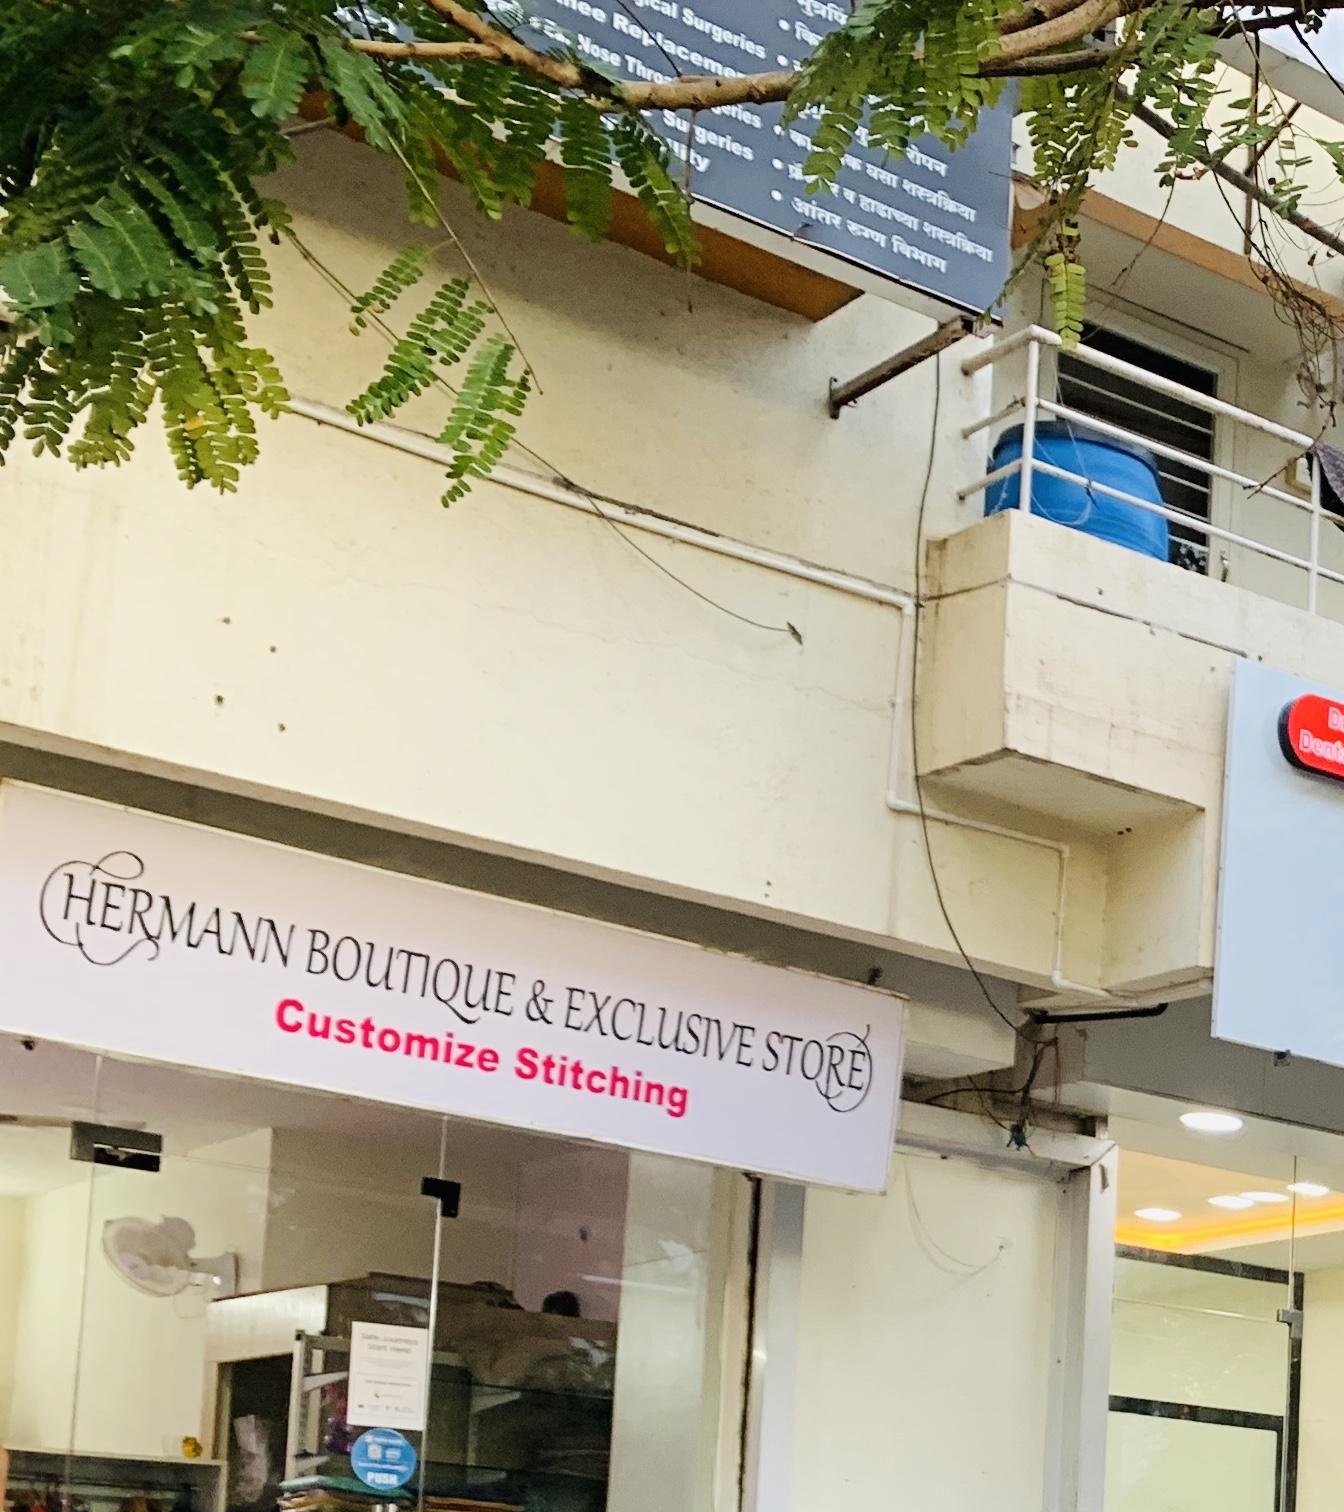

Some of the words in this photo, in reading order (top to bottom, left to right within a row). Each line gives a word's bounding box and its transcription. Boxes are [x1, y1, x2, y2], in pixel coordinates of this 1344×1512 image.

[612, 12, 748, 78] Replaceme
[682, 7, 767, 59] Surgeries
[624, 54, 673, 84] Thro
[41, 851, 295, 966] HERMANN
[306, 929, 516, 1024] BOUTIQUE
[525, 979, 554, 1025] &
[565, 986, 756, 1068] EXCLUSIVE
[762, 1024, 873, 1112] STORE
[275, 998, 500, 1073] Customize
[514, 1047, 689, 1118] Stitching
